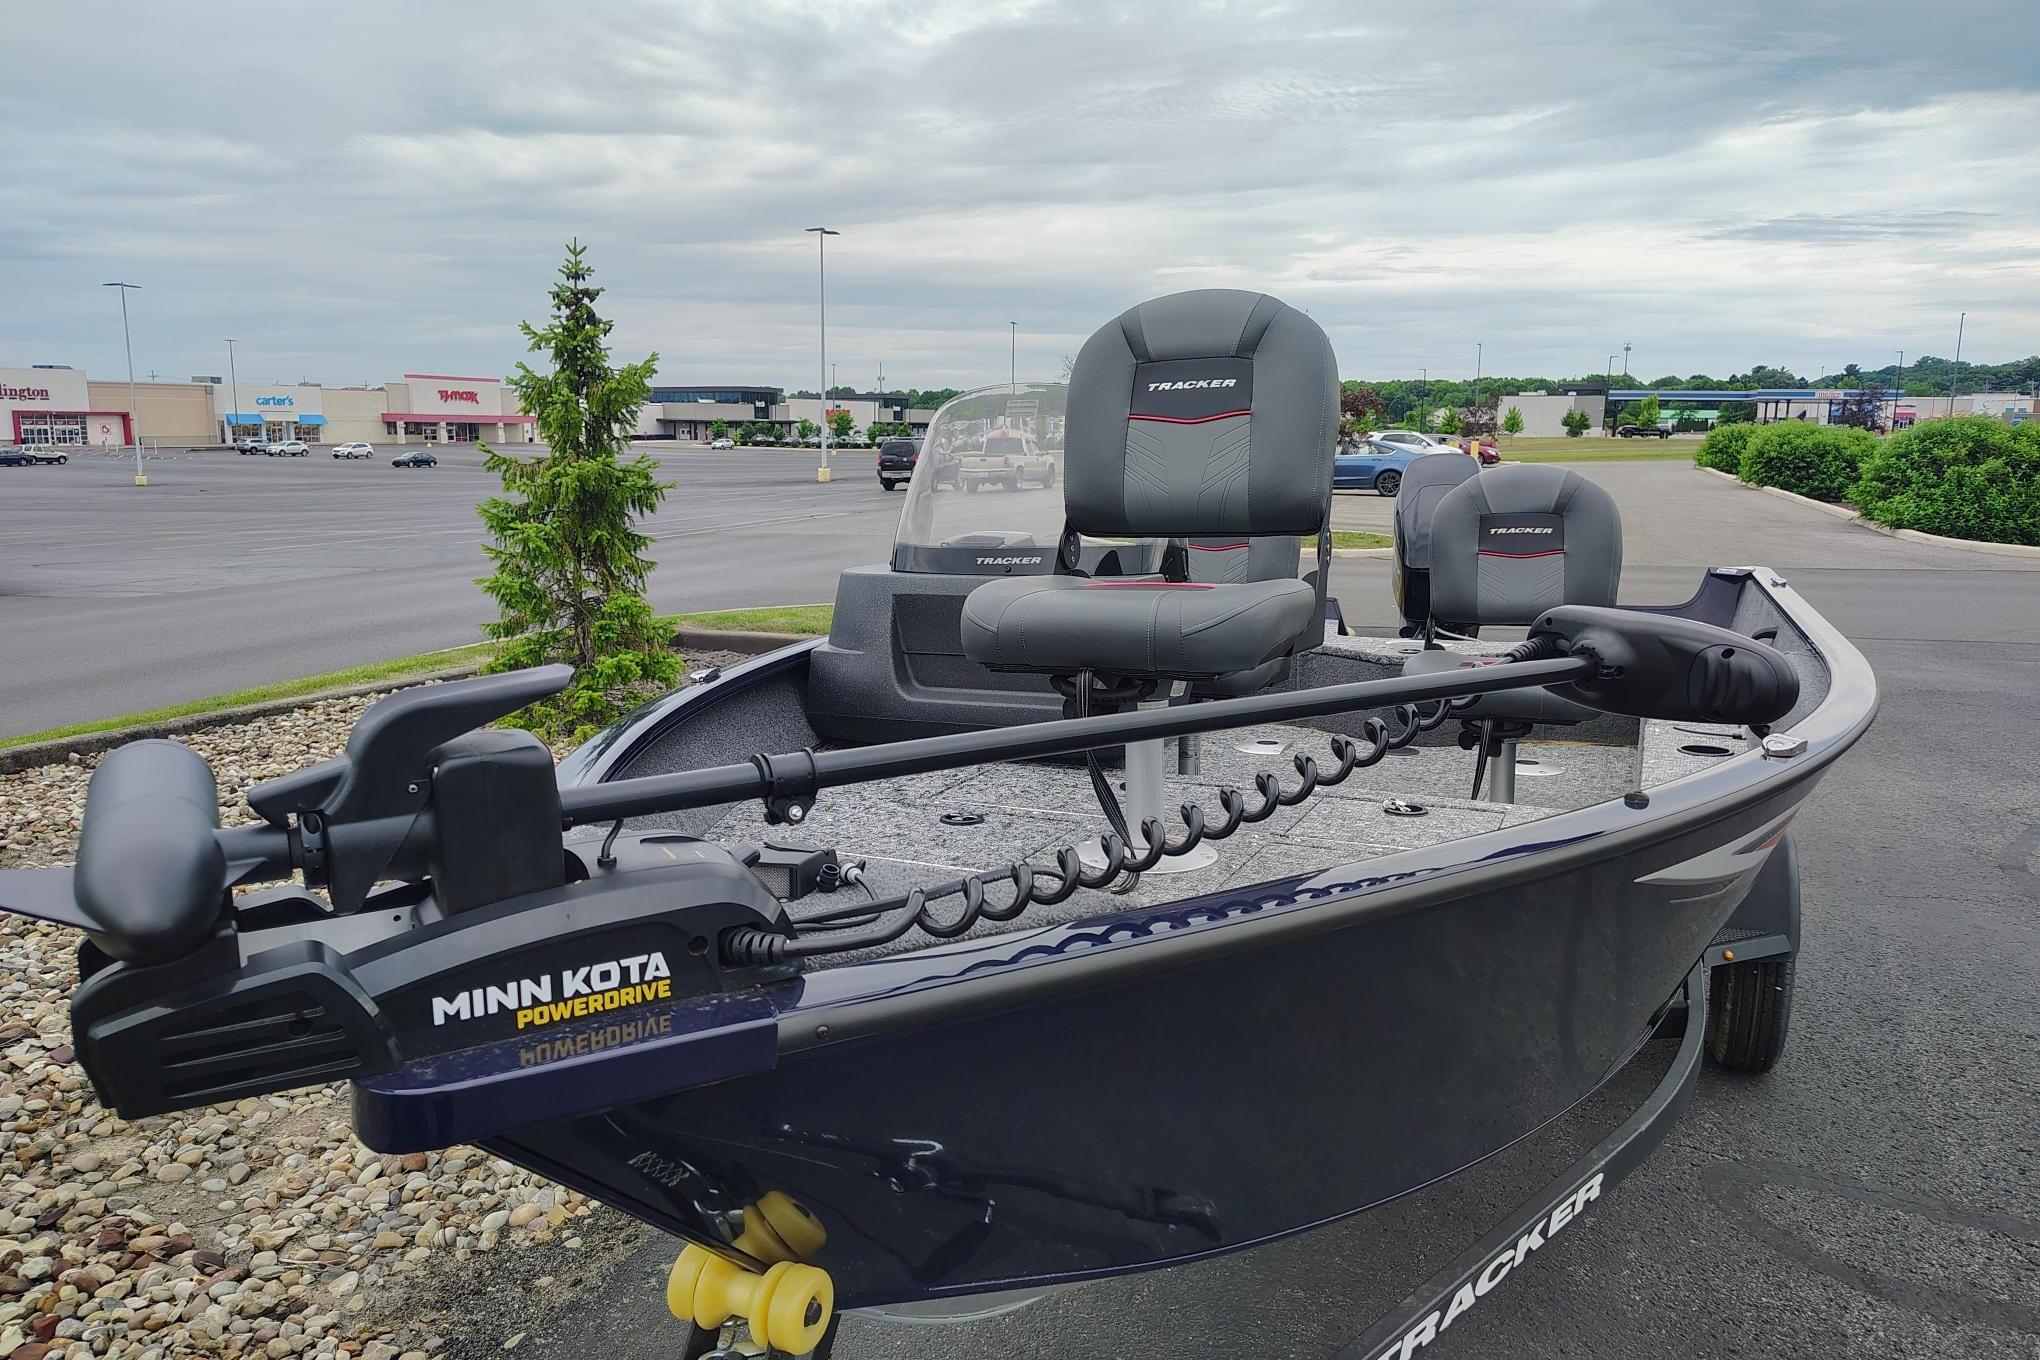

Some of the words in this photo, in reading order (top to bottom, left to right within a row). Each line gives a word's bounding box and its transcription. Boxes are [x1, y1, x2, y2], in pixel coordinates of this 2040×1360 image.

[1147, 379, 1237, 391] TRACKER
[255, 395, 294, 406] carter's
[1488, 527, 1553, 535] TRACKER
[976, 556, 1042, 565] TRACKER
[431, 974, 551, 1026] MINN
[562, 951, 671, 998] KOTA
[516, 979, 672, 1030] POWERDRIVE
